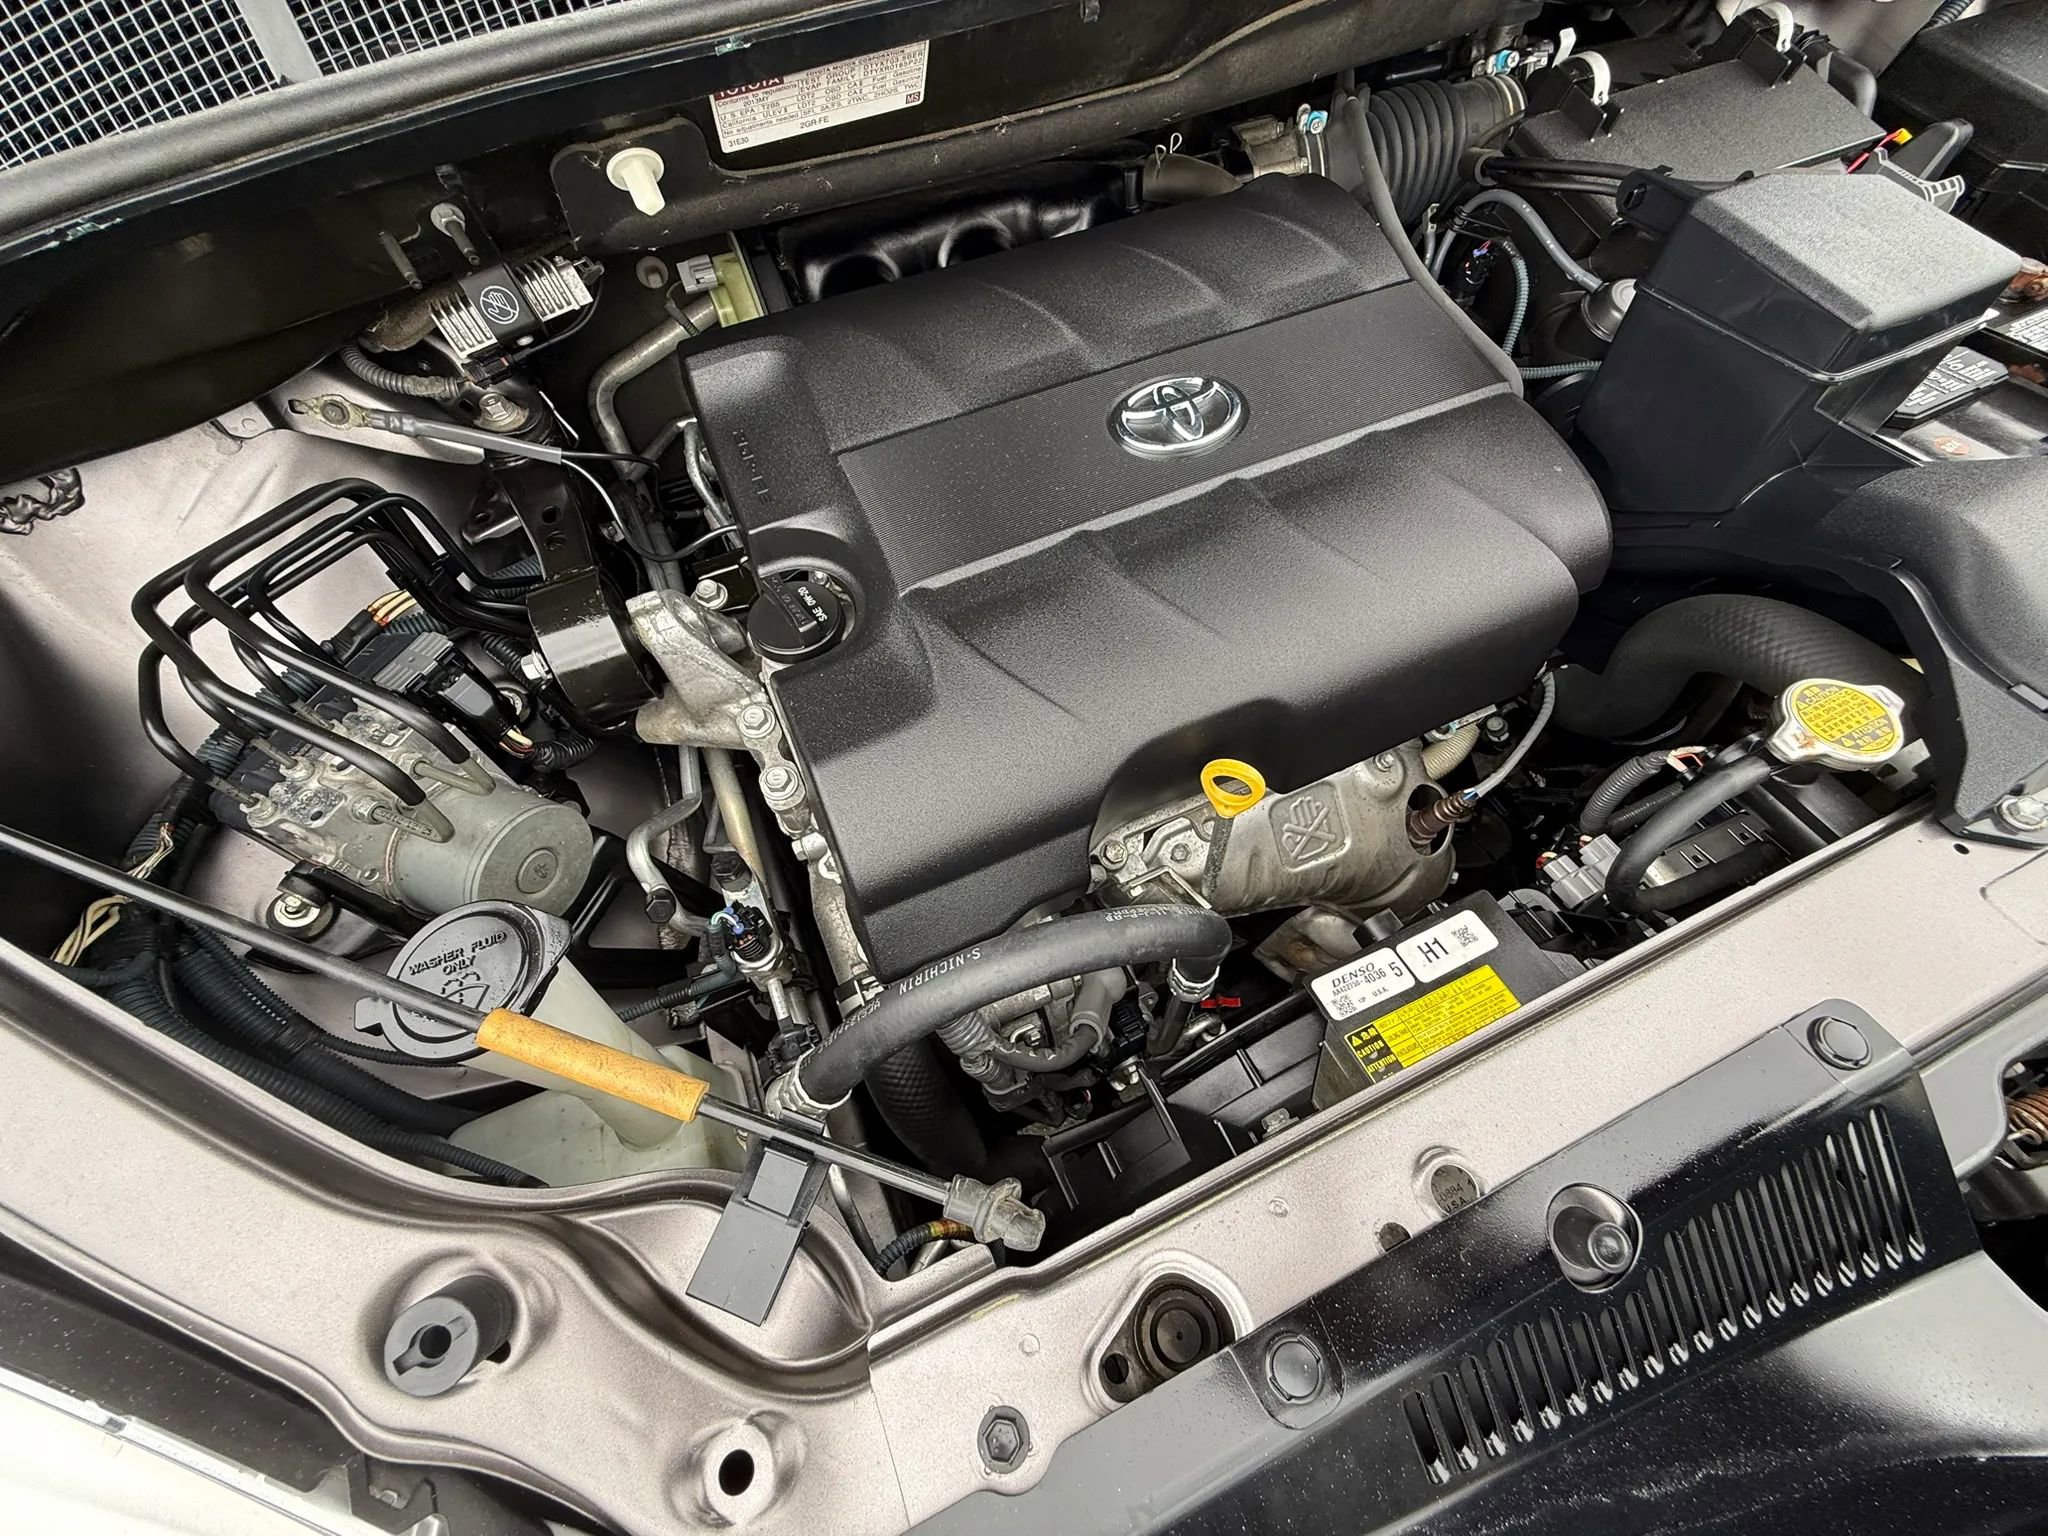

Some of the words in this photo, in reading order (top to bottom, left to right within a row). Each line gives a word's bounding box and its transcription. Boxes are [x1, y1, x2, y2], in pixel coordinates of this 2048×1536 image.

[800, 76, 820, 85] TEST
[826, 67, 856, 80] GROUP
[826, 74, 856, 85] FAMILY
[892, 66, 922, 78] Gasoline
[717, 95, 749, 107] Conforms
[762, 83, 797, 97] regulations
[721, 116, 757, 129] California
[775, 113, 799, 123] needed
[728, 136, 749, 148] 31E30
[797, 586, 816, 606] 0W-20
[812, 606, 828, 622] SAE
[409, 947, 465, 976] WASHER
[471, 931, 508, 953] FLUID
[1417, 937, 1449, 964] H1
[443, 955, 477, 976] ONLY
[1331, 962, 1375, 988] DENSO
[1387, 961, 1404, 978] 5
[1356, 1039, 1385, 1060] CAUTION
[1366, 1053, 1397, 1074] ATTENTION
